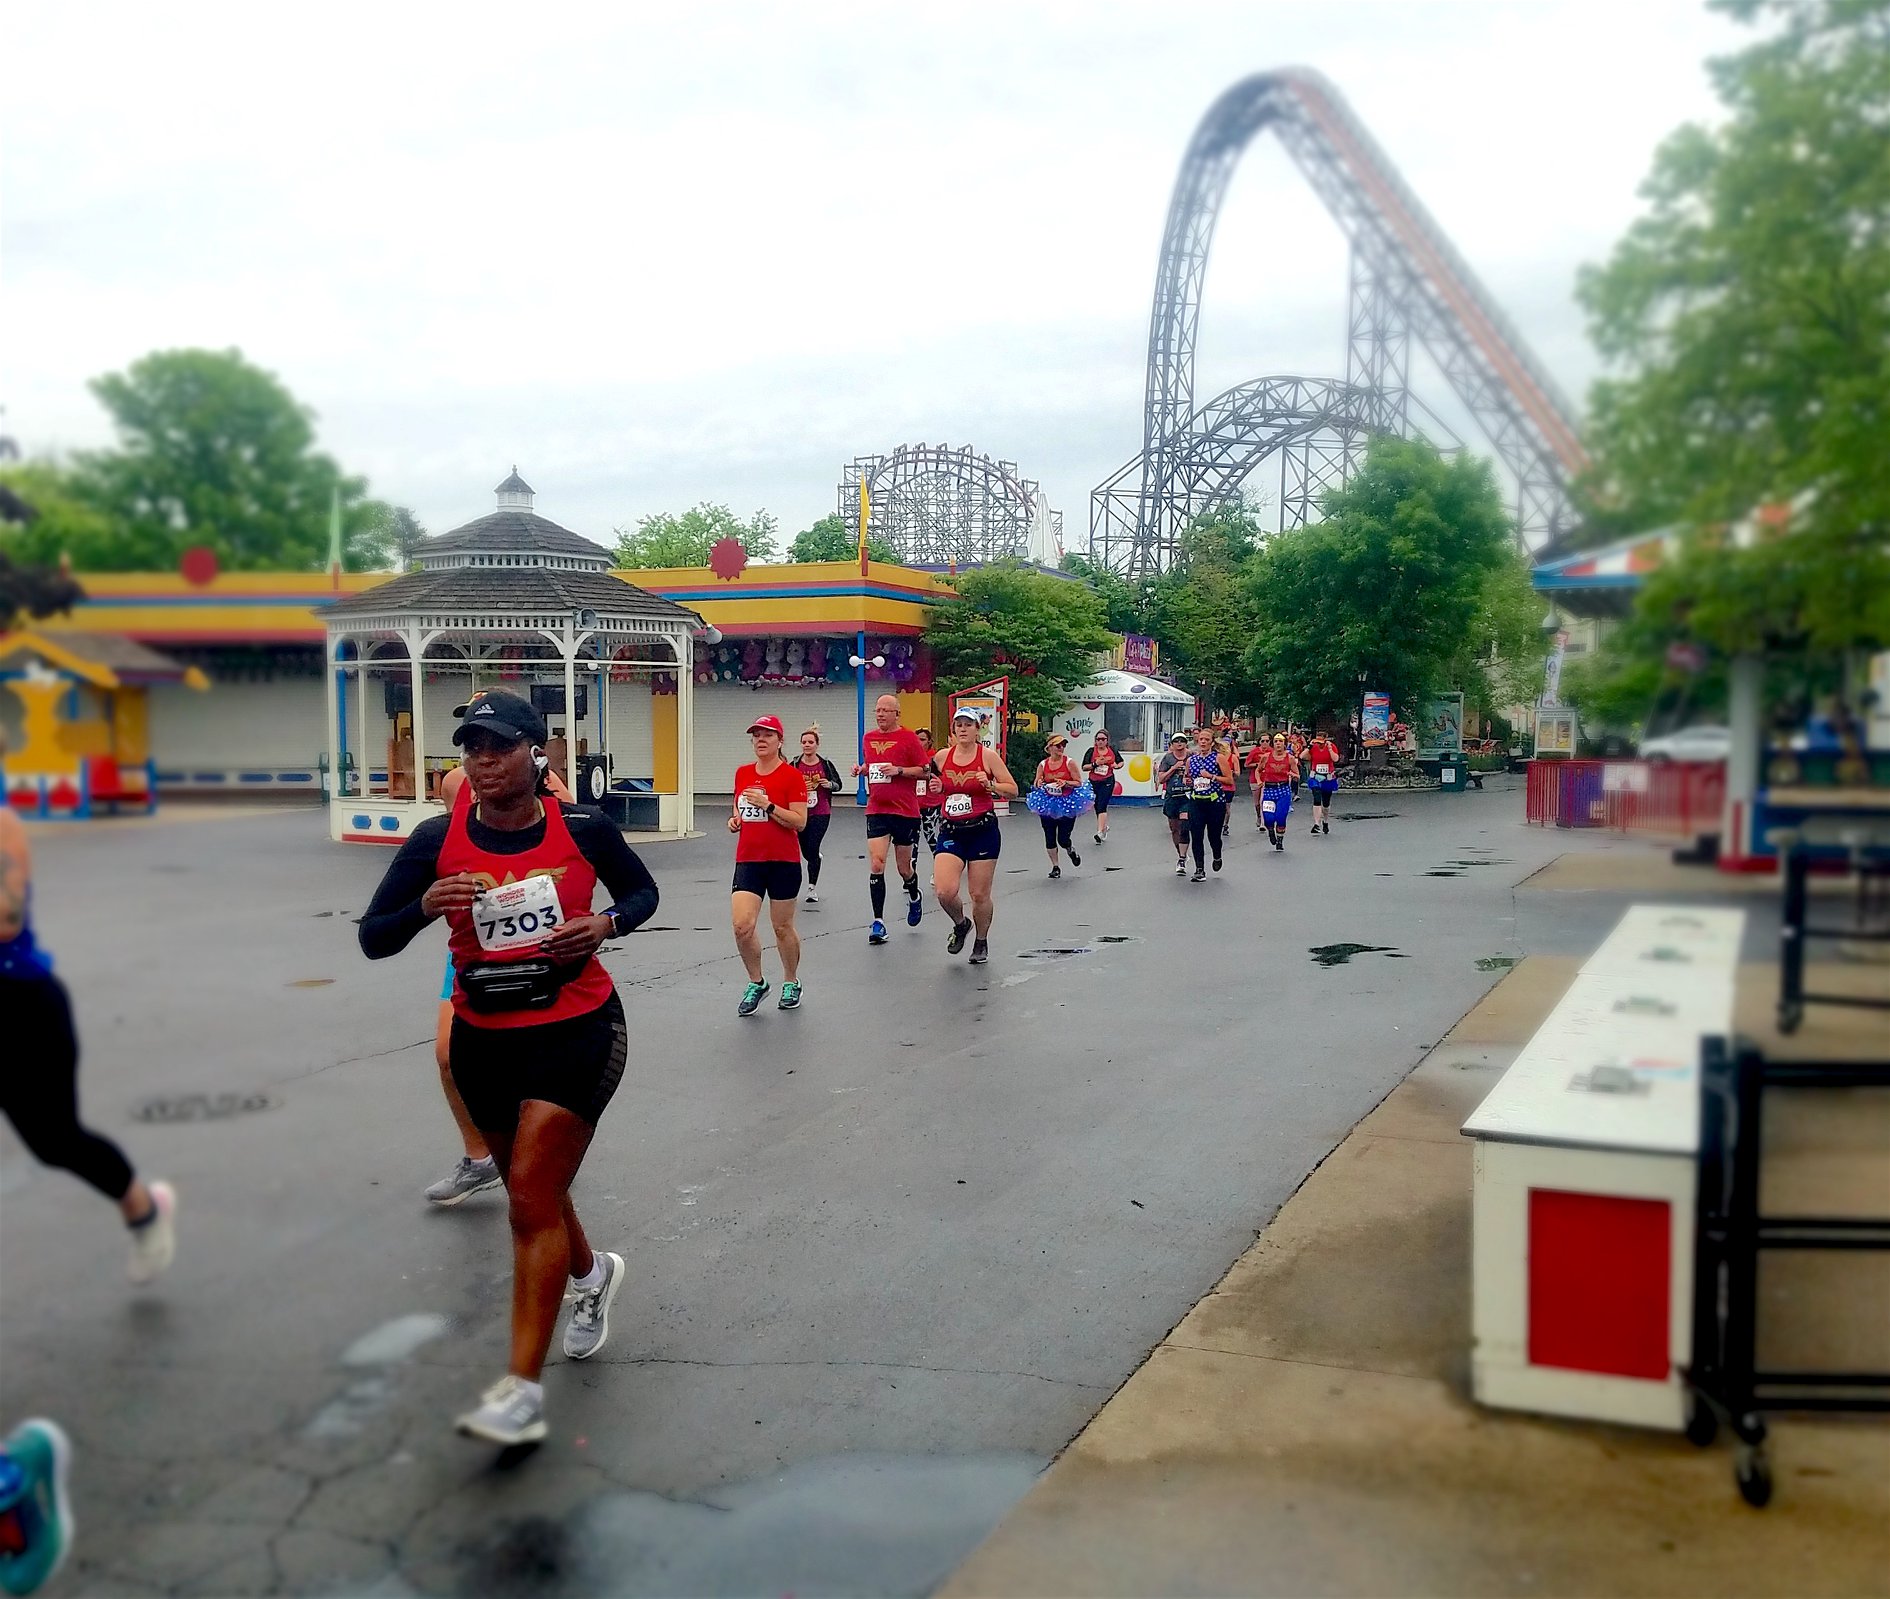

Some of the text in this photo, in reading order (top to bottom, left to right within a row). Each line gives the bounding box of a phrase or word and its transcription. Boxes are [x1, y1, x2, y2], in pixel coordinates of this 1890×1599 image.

[946, 802, 971, 812] 7608
[495, 888, 525, 899] WONDER
[498, 893, 525, 903] WOMAN
[480, 905, 557, 940] 7303
